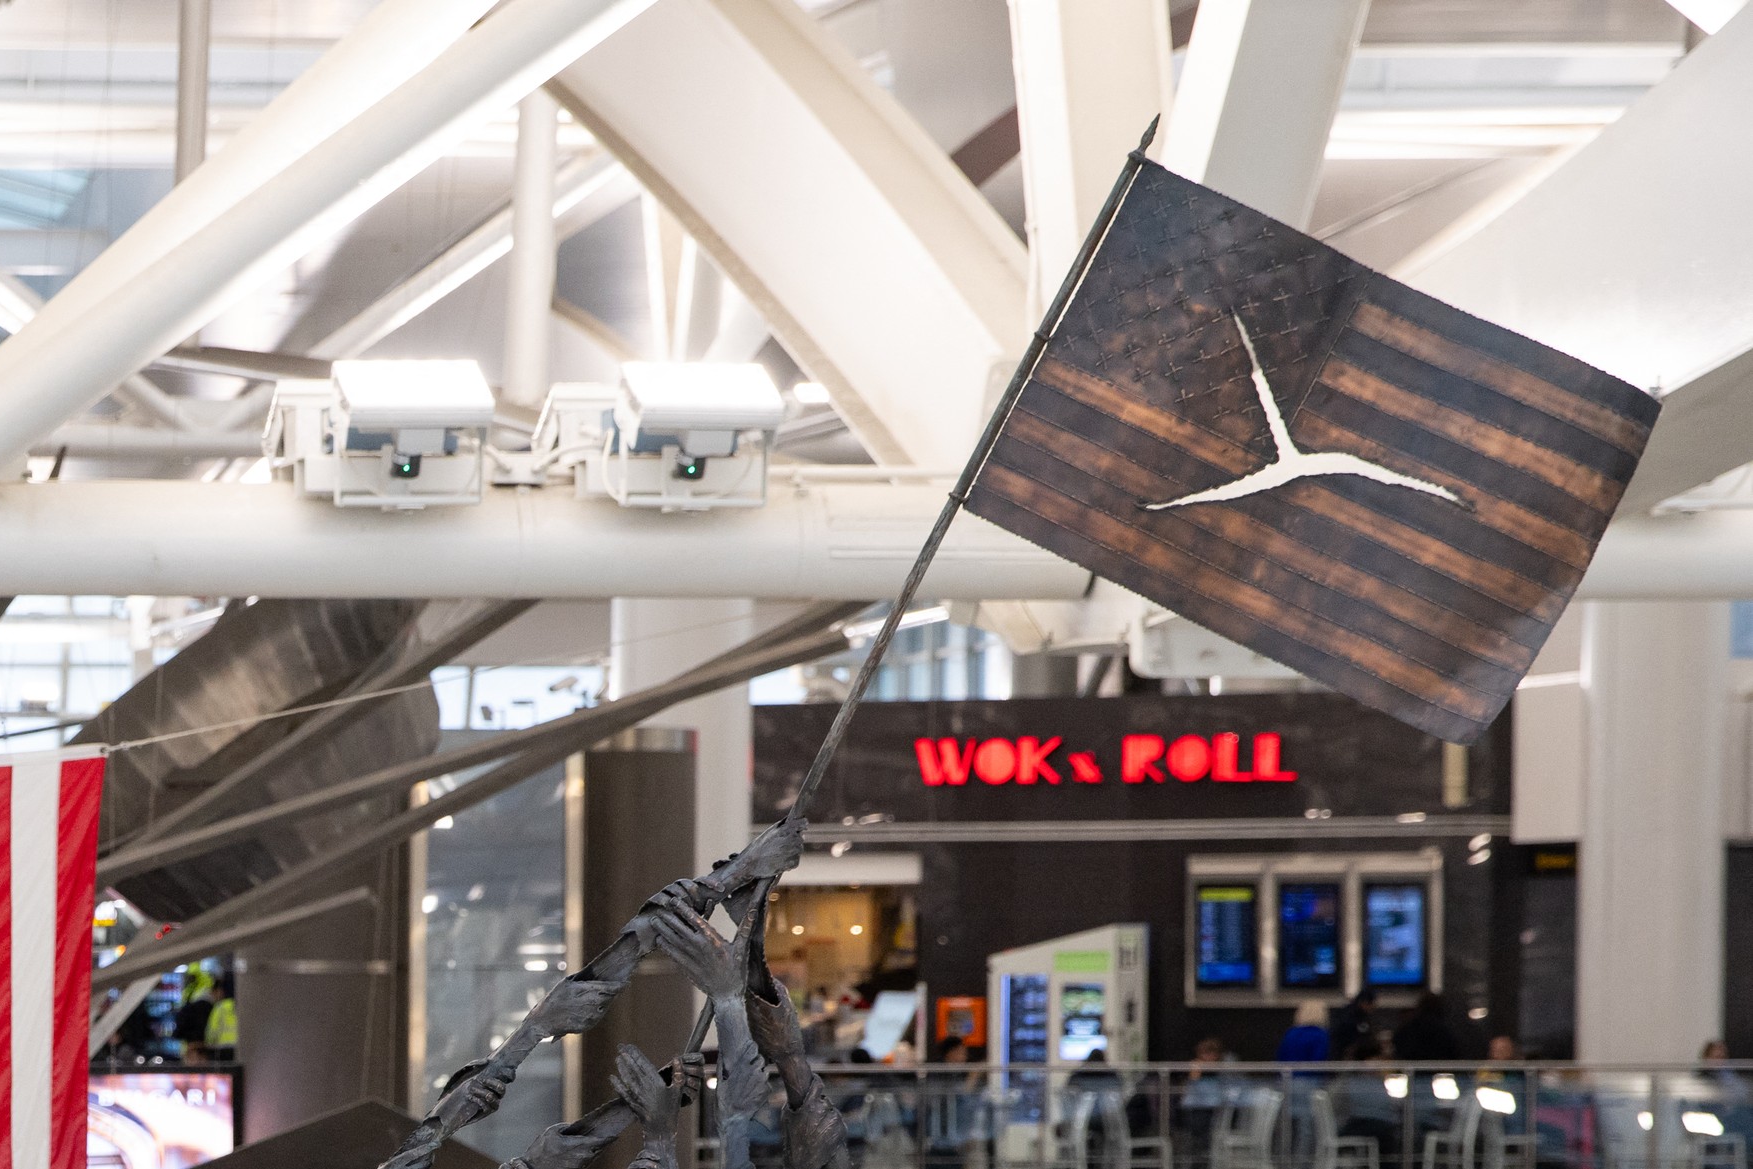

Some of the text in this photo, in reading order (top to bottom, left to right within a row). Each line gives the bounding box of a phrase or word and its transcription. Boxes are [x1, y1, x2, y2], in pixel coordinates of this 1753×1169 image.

[914, 735, 1062, 786] WOK
[1121, 732, 1298, 784] ROLL
[97, 1088, 216, 1107] BGARI
